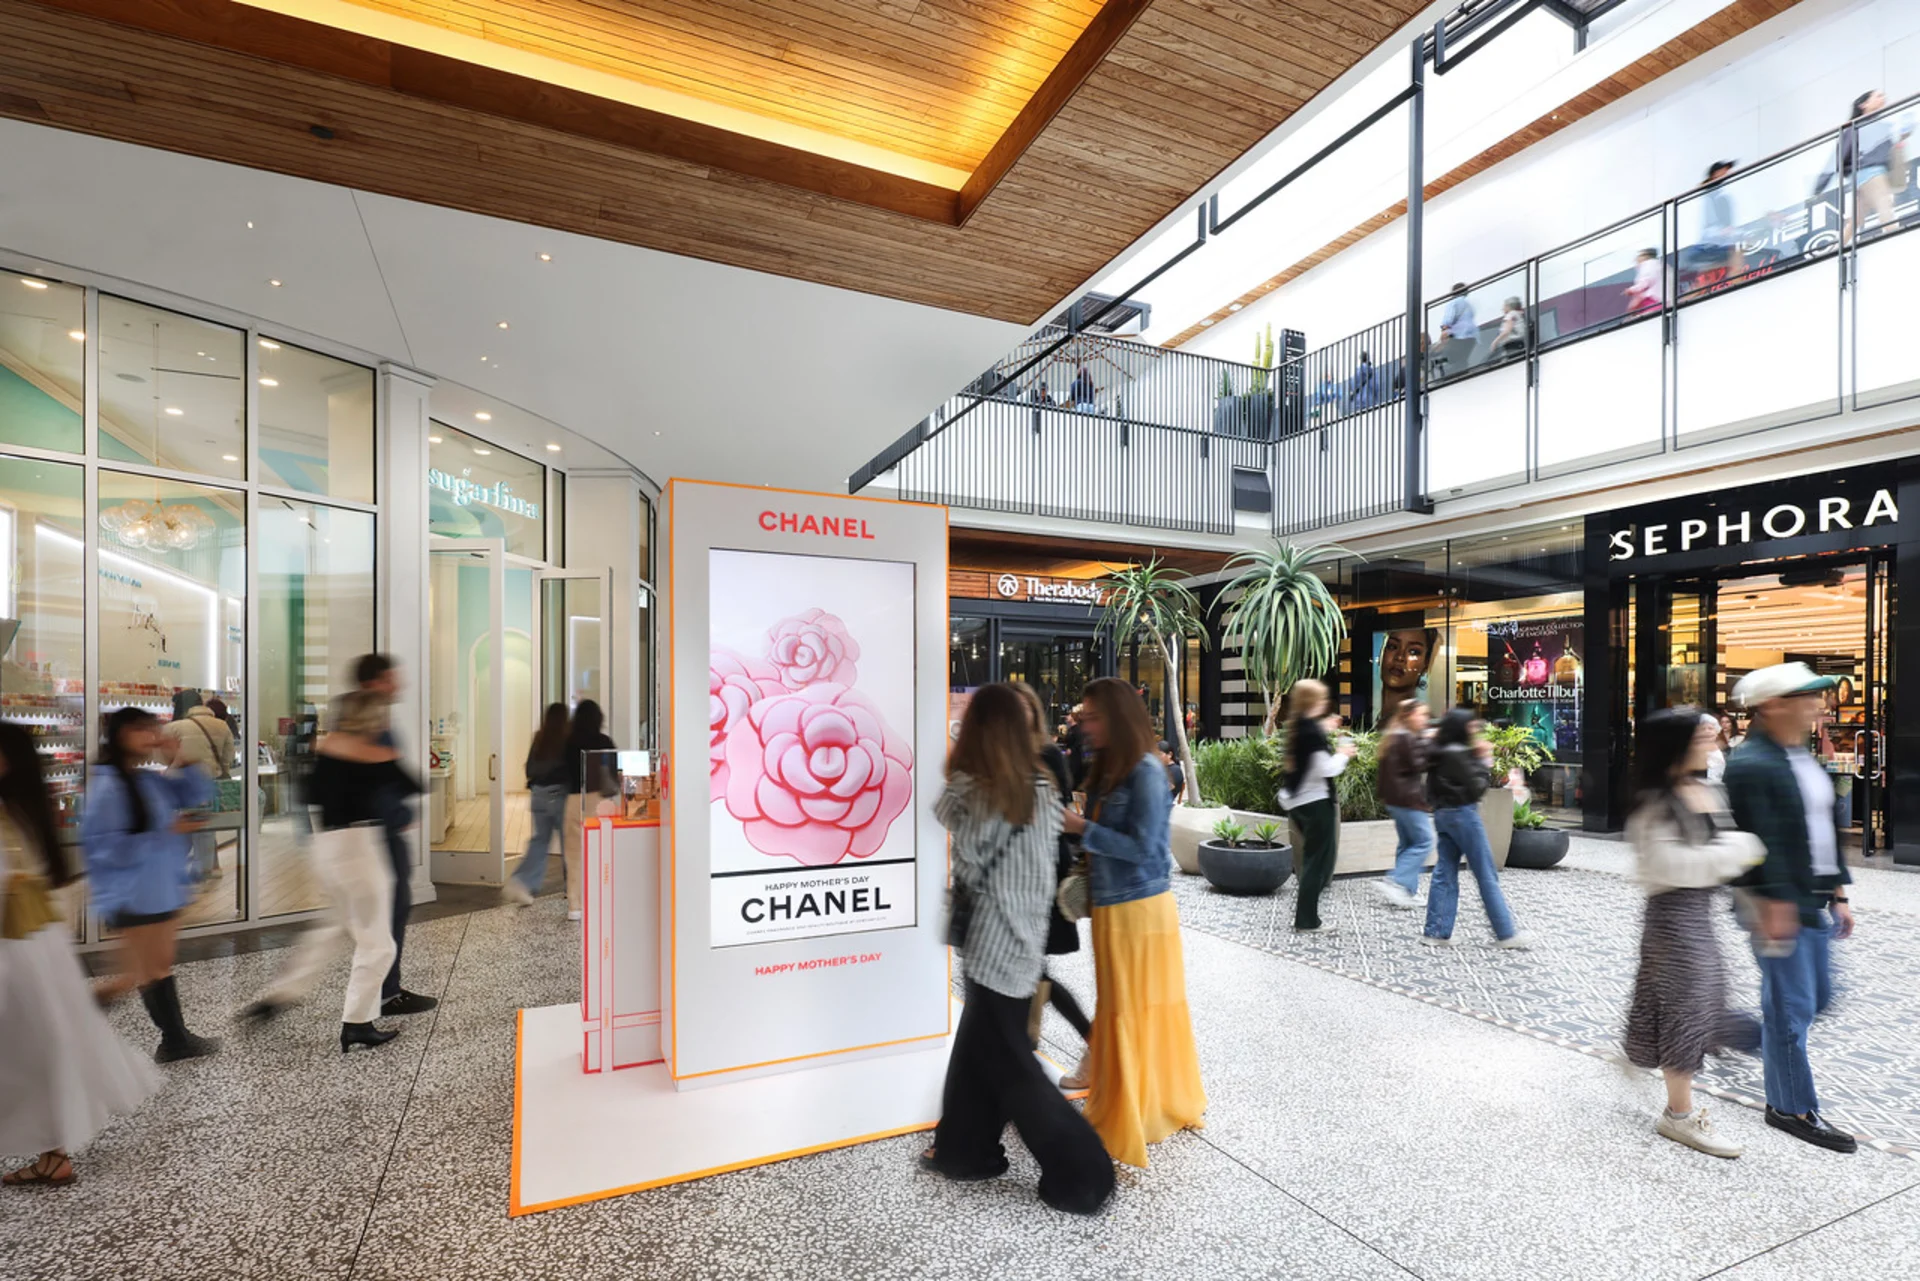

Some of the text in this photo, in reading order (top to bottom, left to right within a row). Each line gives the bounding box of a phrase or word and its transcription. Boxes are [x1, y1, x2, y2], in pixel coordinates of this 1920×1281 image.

[429, 467, 540, 520] sugarfina
[758, 510, 876, 540] CHANEL
[1611, 488, 1899, 561] SEPHORA
[1024, 577, 1104, 604] Therabody
[765, 875, 870, 891] HAPPY MOTHER'S DAY
[740, 886, 892, 924] CHANEL
[755, 952, 883, 976] HAPPY MOTHER'S DAY
